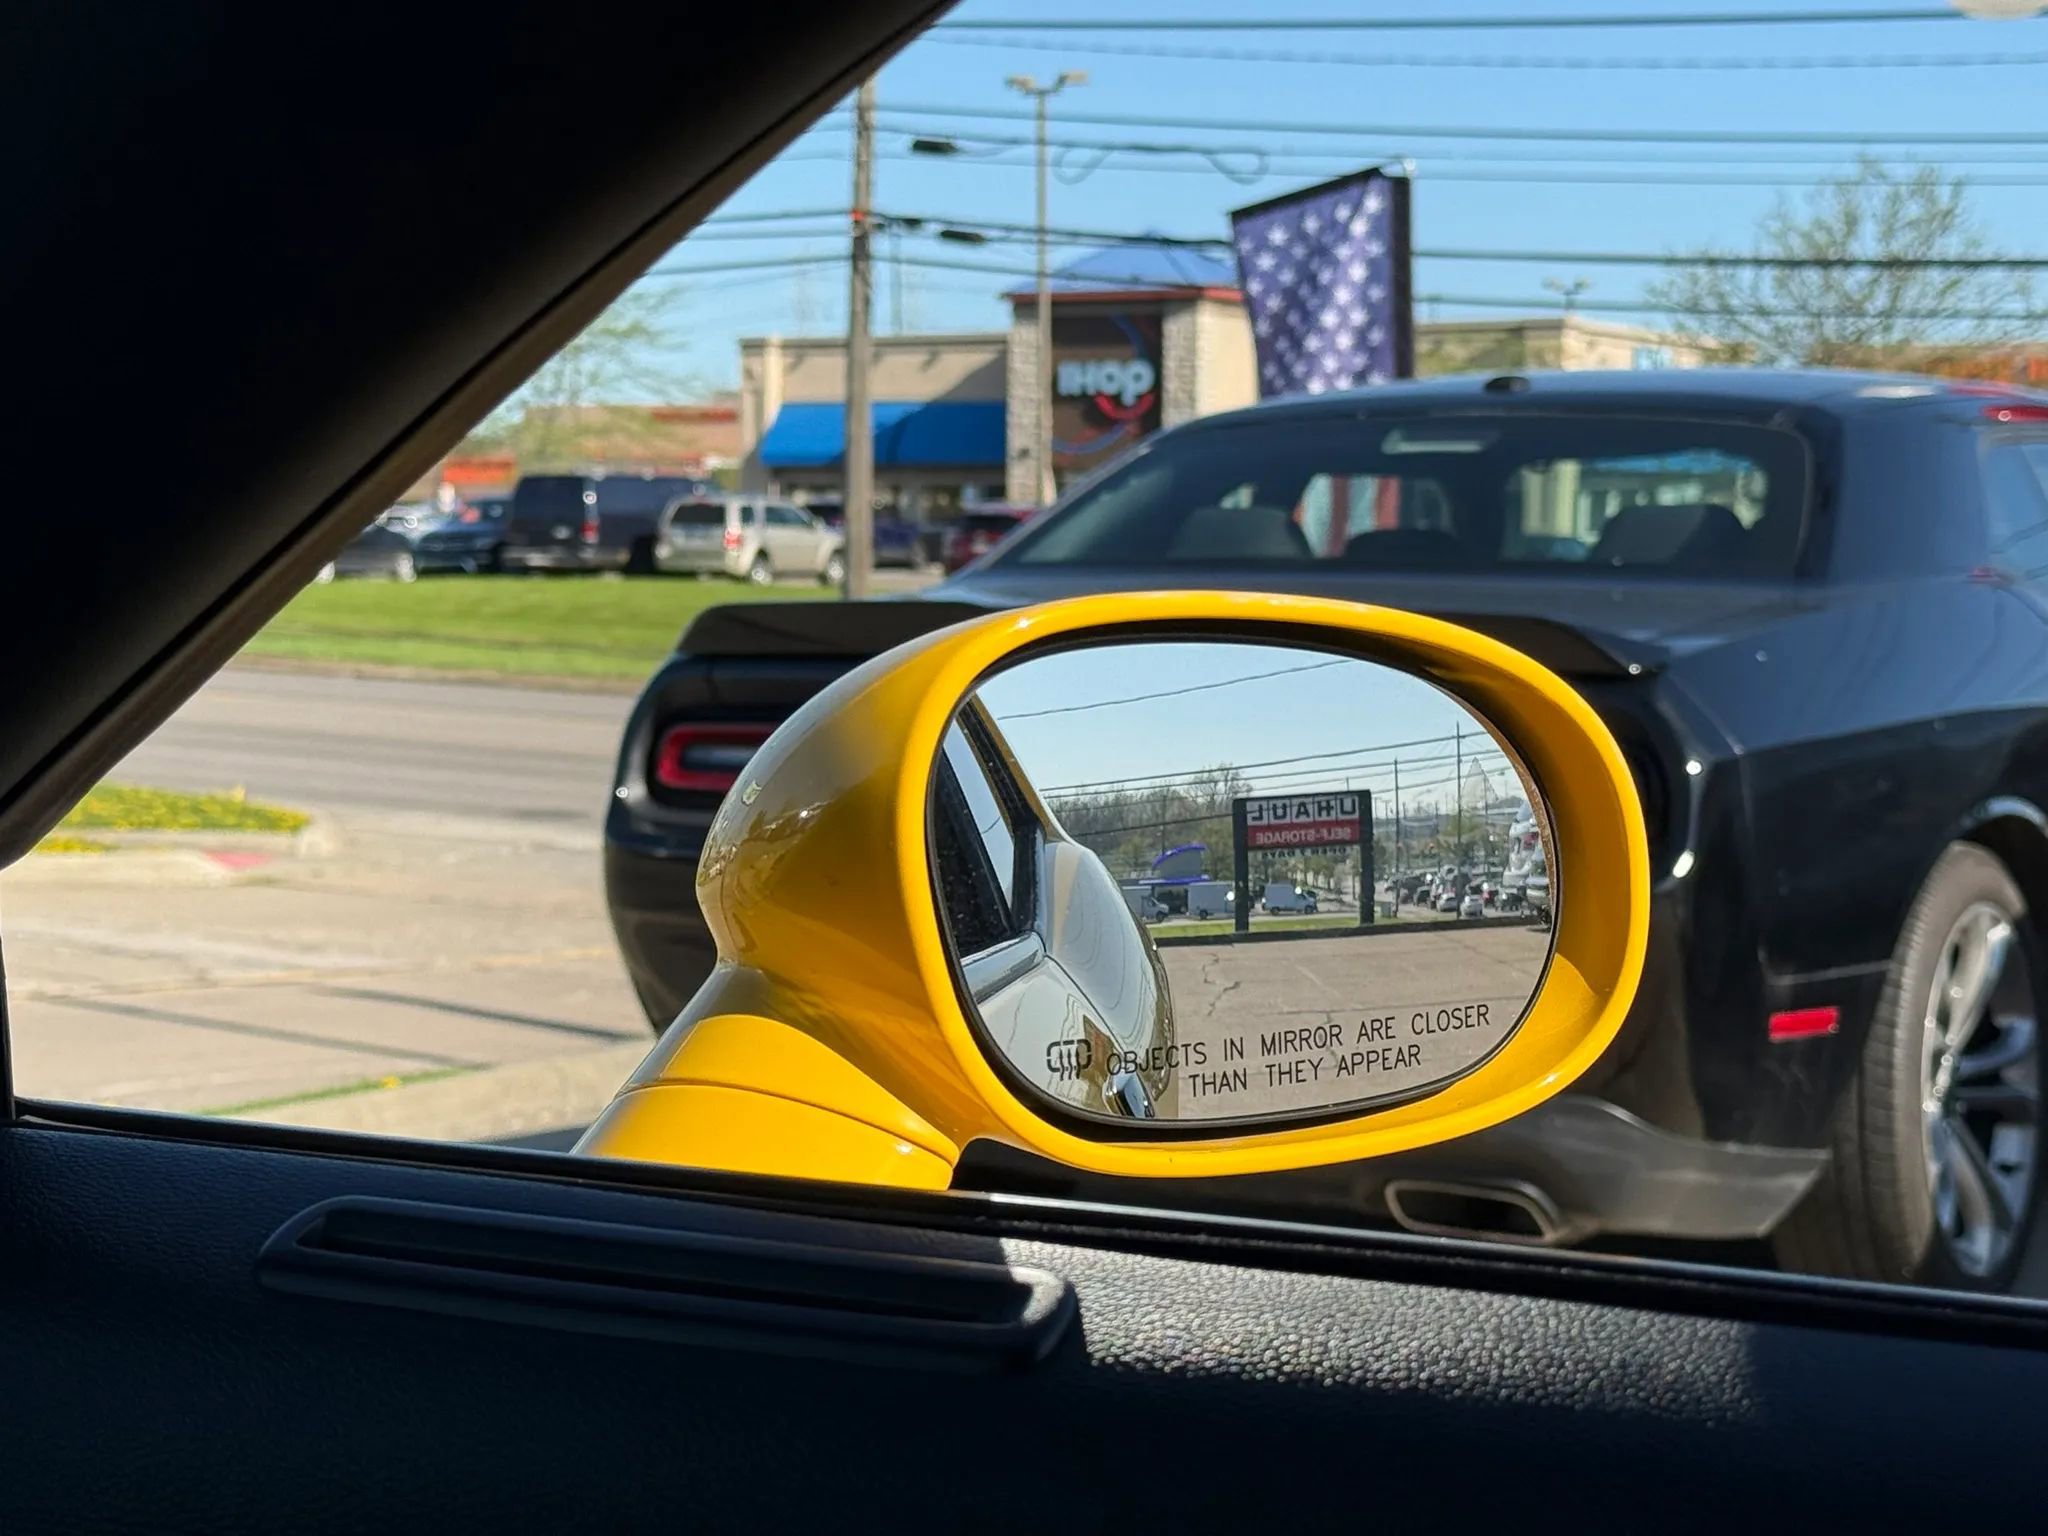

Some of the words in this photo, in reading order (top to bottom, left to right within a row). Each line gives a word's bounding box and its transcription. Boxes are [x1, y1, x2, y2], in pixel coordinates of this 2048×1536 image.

[1106, 1041, 1207, 1077] OBJECTS
[1223, 1037, 1245, 1061] IN
[1260, 1024, 1343, 1056] MIRROR
[1357, 1016, 1396, 1042] ARE
[1411, 1004, 1491, 1035] CLOSER
[1188, 1072, 1248, 1098] THAN
[1265, 1057, 1323, 1090] THEY
[1336, 1043, 1422, 1076] APPEAR
